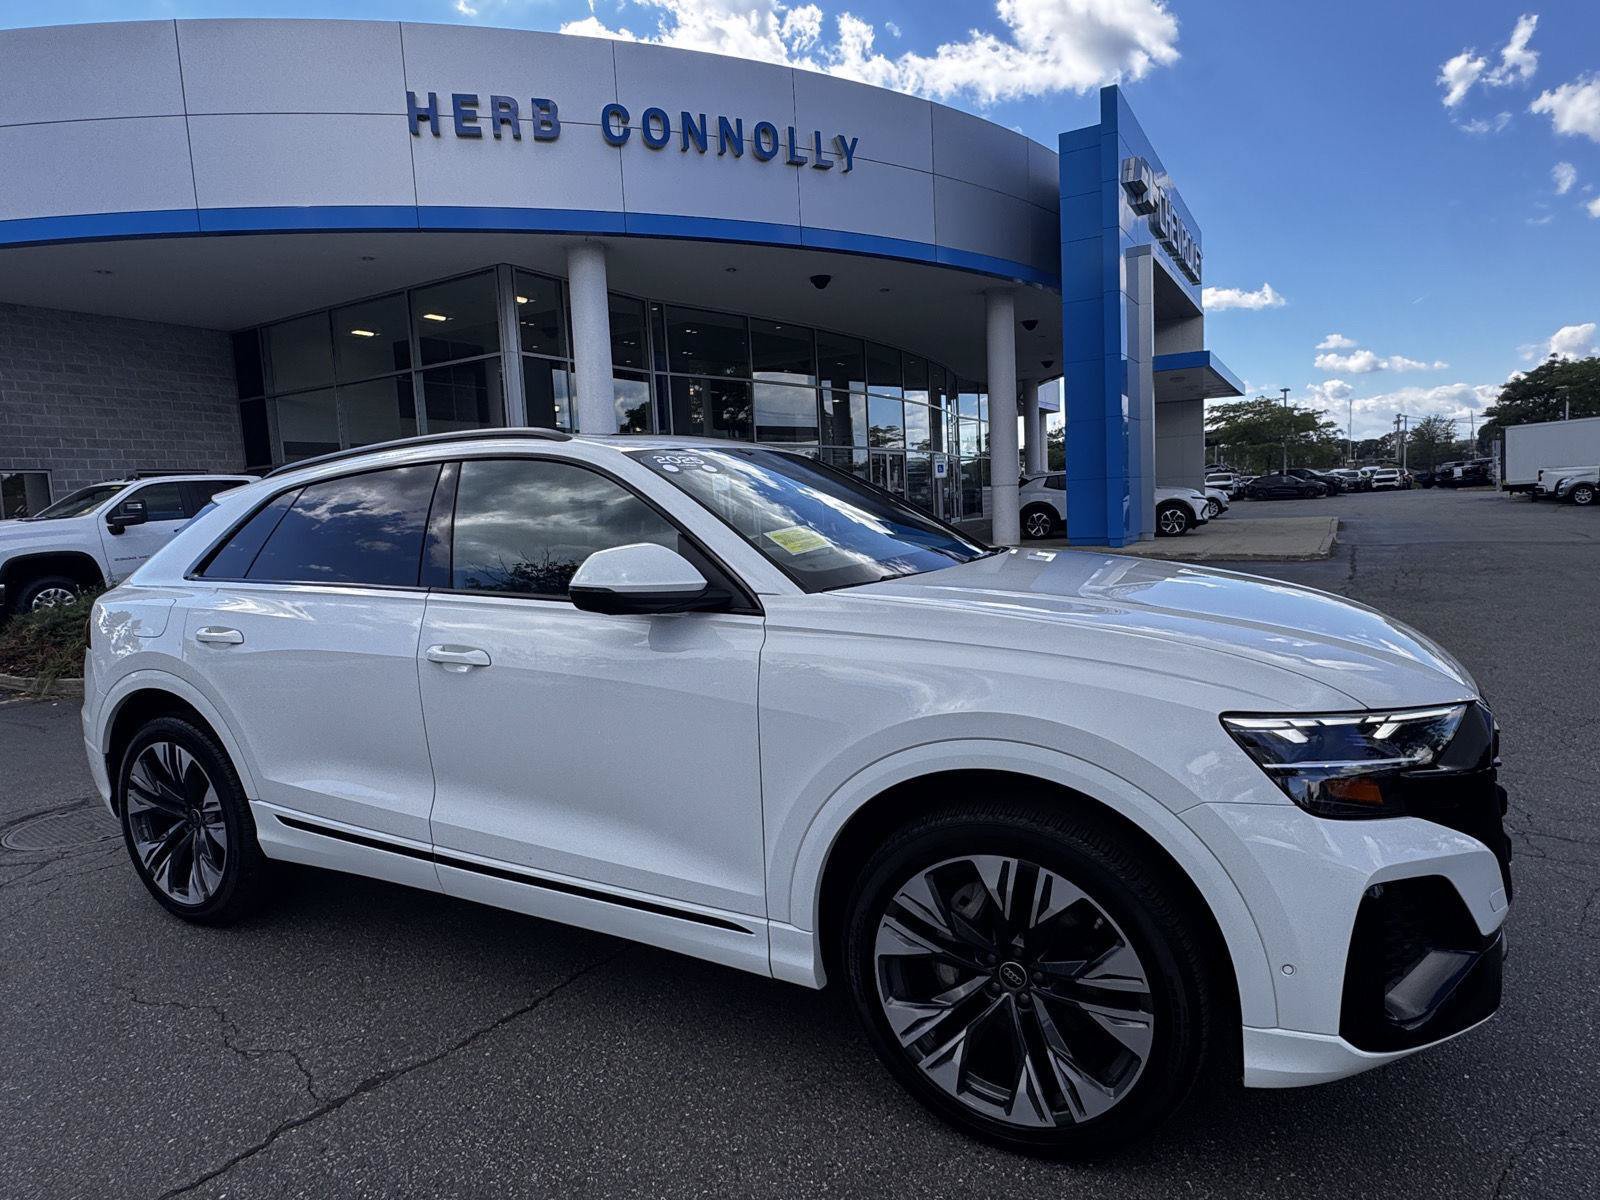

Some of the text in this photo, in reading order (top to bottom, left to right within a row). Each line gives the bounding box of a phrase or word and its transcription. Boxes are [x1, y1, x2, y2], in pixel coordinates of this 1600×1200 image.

[406, 91, 859, 173] HERB CONNOLLY
[1149, 185, 1203, 285] CHEVROLE
